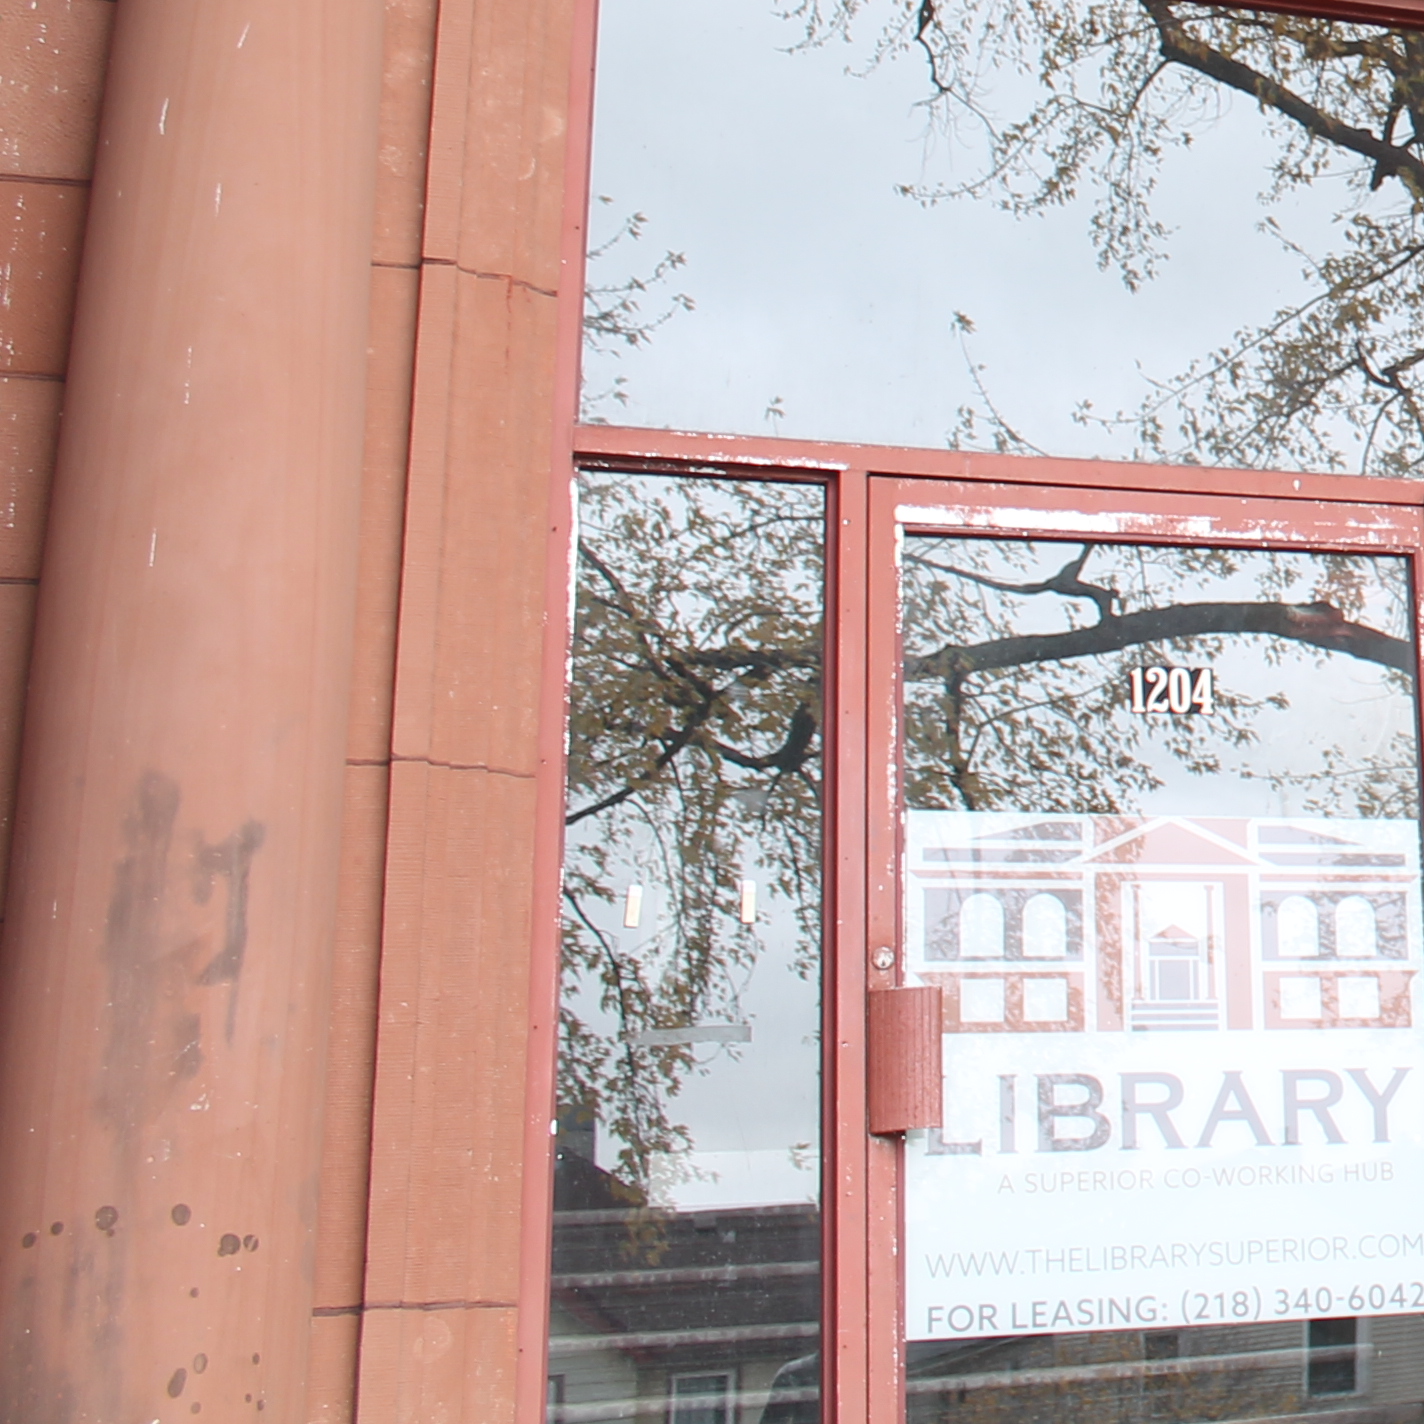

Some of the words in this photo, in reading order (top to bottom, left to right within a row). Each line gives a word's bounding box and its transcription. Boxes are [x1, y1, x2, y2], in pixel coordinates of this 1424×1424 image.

[1129, 665, 1215, 715] 1204
[997, 1174, 1015, 1195] A
[1024, 1169, 1154, 1194] SUPERIOR
[1163, 1163, 1335, 1189] CO-WORKING
[1343, 1161, 1395, 1183] HUB
[924, 1232, 1424, 1279] WWW.THELIBRARYSUPERIOR.COM
[926, 1303, 999, 1334] FOR
[1010, 1295, 1169, 1330] LEASING:
[1180, 1285, 1262, 1325] (218)
